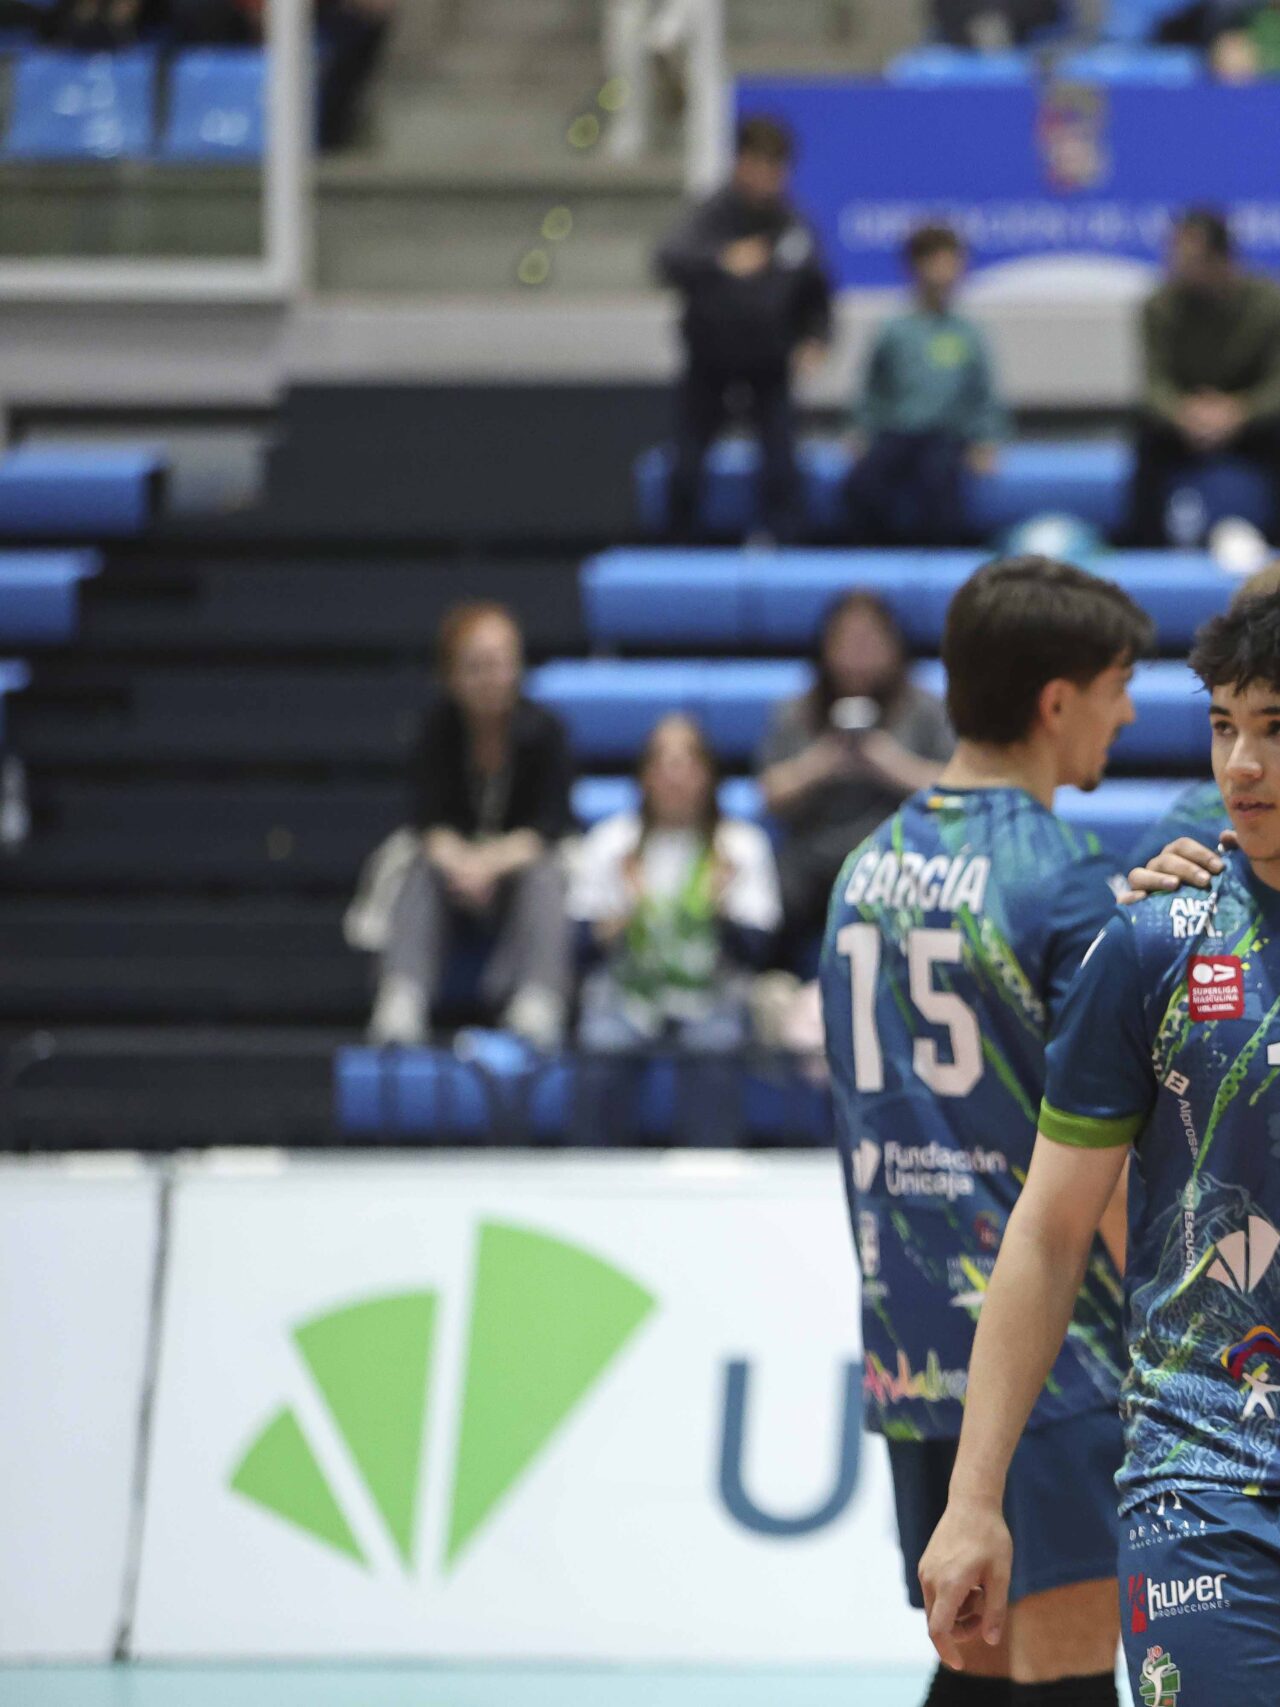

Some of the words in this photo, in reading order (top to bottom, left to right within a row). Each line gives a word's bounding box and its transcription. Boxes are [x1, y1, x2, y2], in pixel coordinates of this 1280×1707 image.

[844, 842, 990, 914] GARCÍA
[836, 921, 984, 1098] 15
[884, 1140, 1007, 1173] Fundación
[885, 1165, 974, 1201] Unicaja
